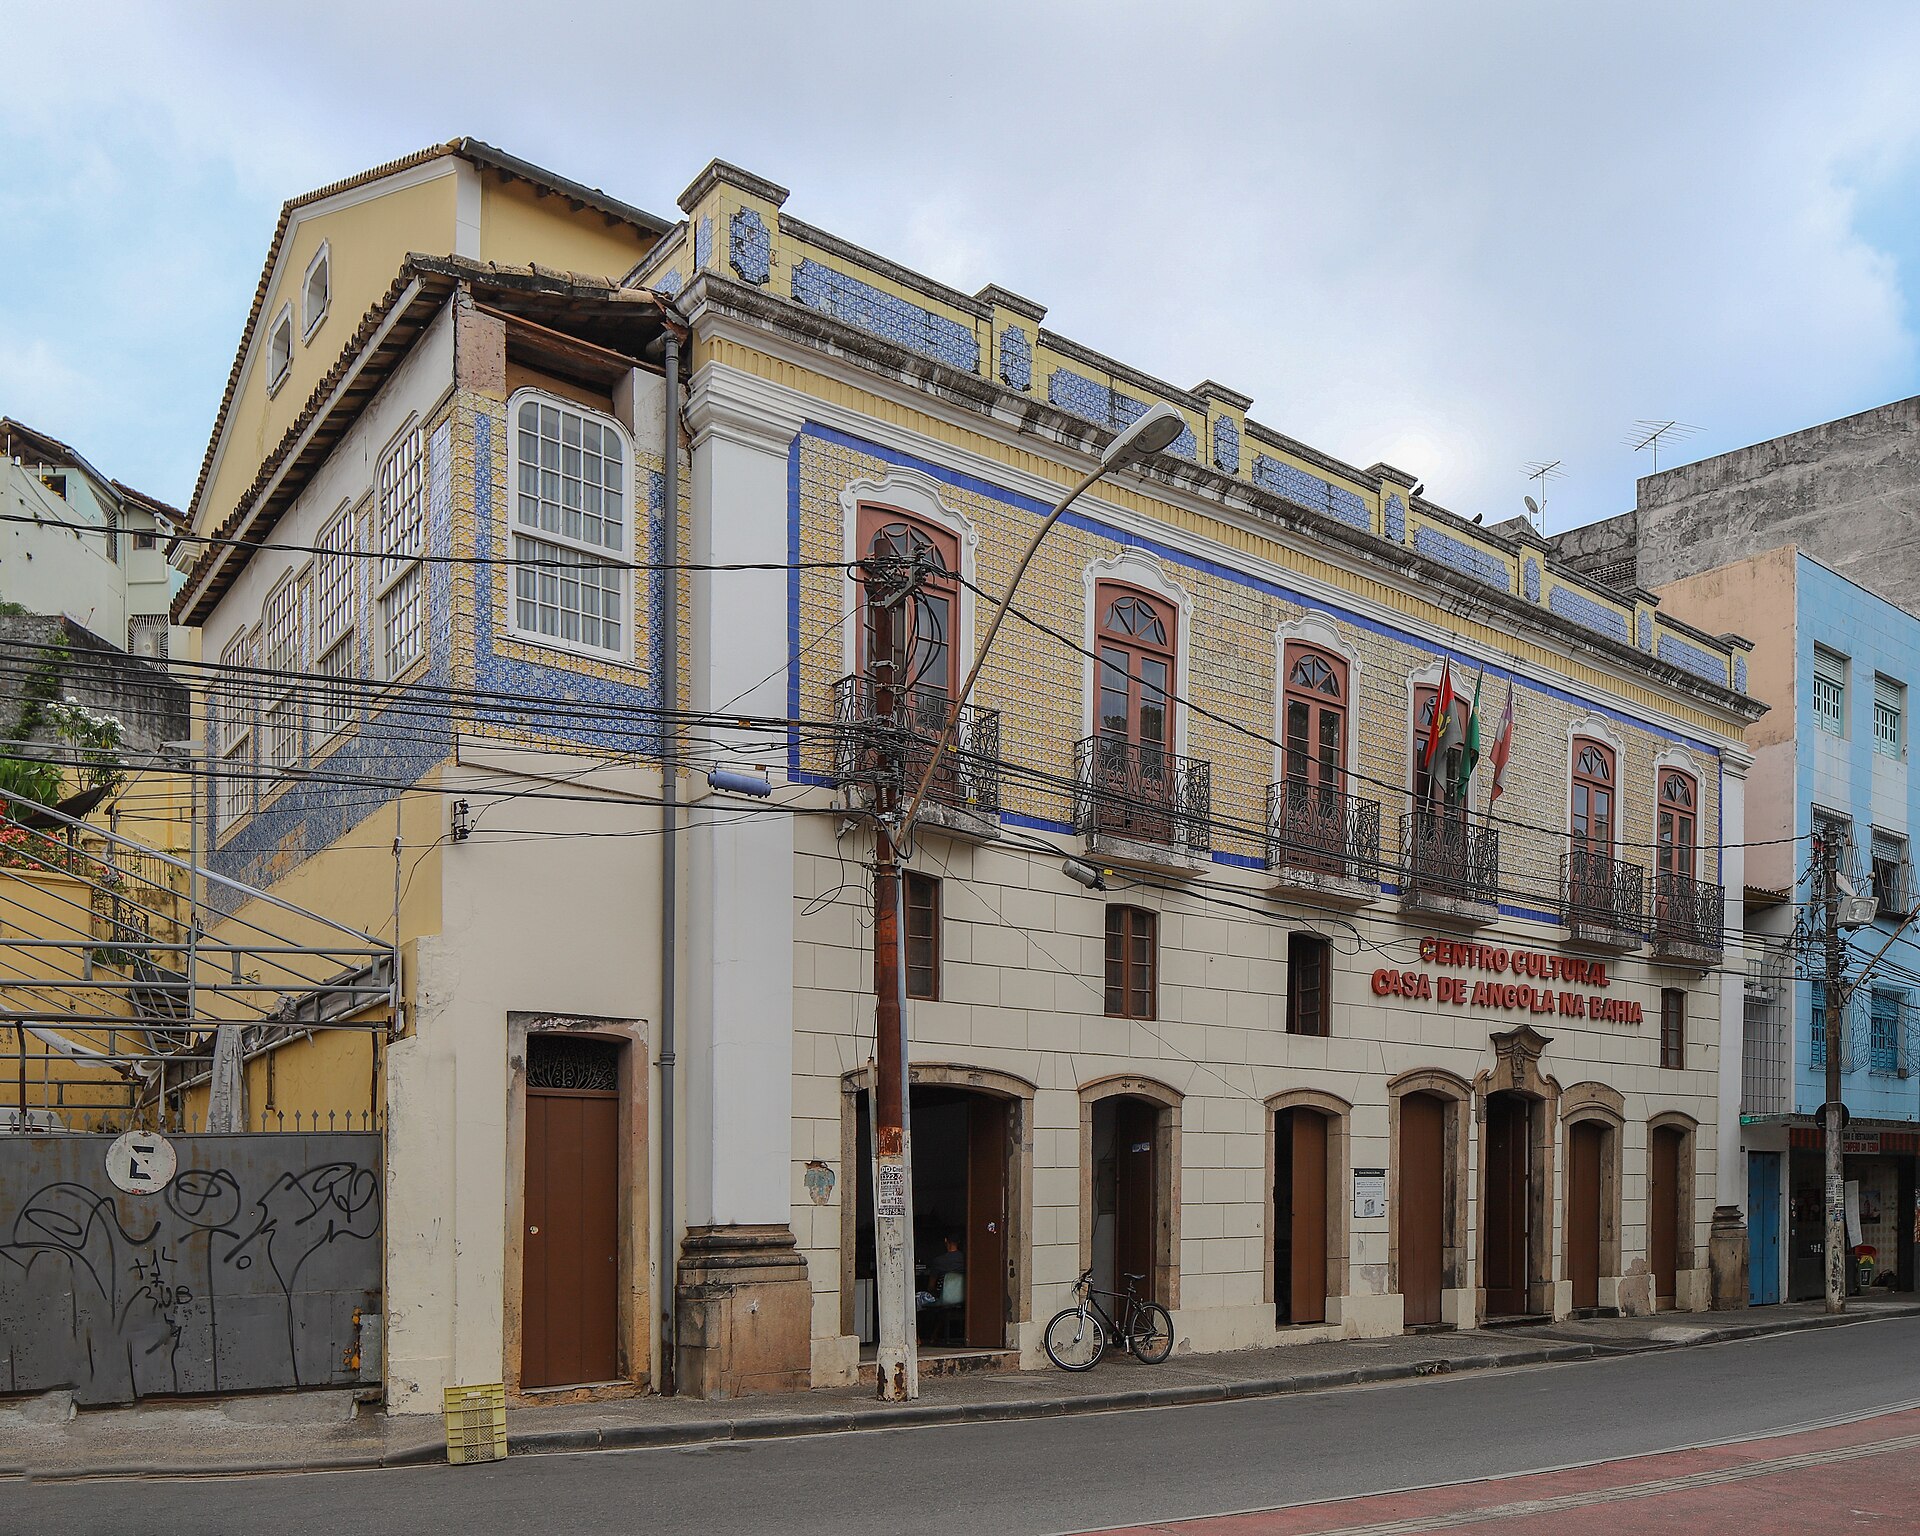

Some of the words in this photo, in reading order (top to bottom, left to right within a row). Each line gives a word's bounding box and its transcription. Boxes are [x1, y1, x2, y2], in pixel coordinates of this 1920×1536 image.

[1419, 936, 1509, 972] CENTRO
[1511, 949, 1611, 987] CULTURAL
[1371, 969, 1432, 999] CASA
[1437, 976, 1467, 1004] DE
[1471, 981, 1556, 1014] ANGOLA
[1559, 991, 1586, 1018] NA
[1589, 996, 1643, 1023] BAHIA
